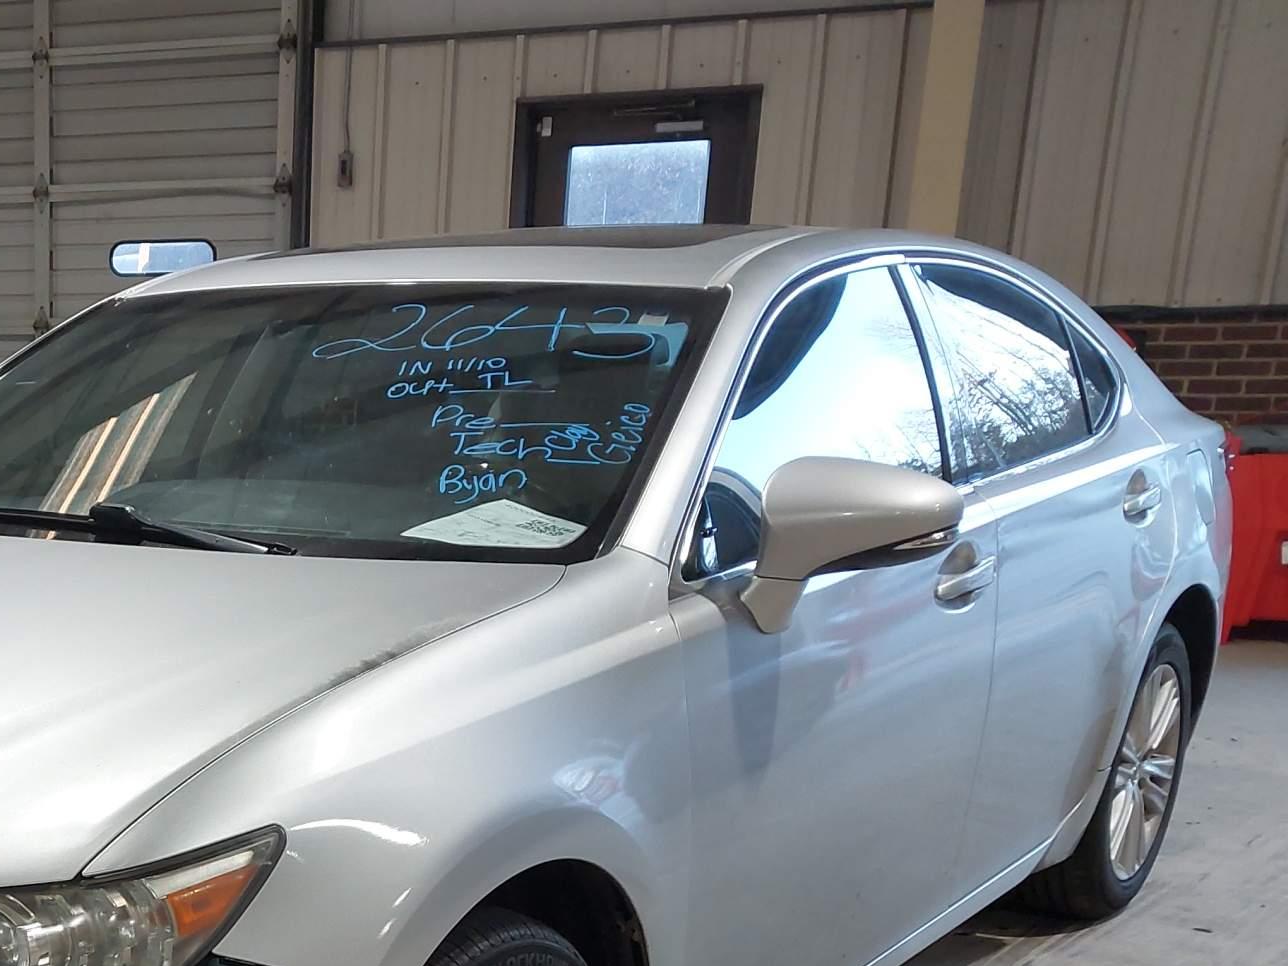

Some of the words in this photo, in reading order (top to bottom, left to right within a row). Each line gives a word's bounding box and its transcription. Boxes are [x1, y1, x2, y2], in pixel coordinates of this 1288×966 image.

[398, 361, 433, 377] IN
[431, 404, 498, 430] Pre
[450, 431, 553, 460] Tech
